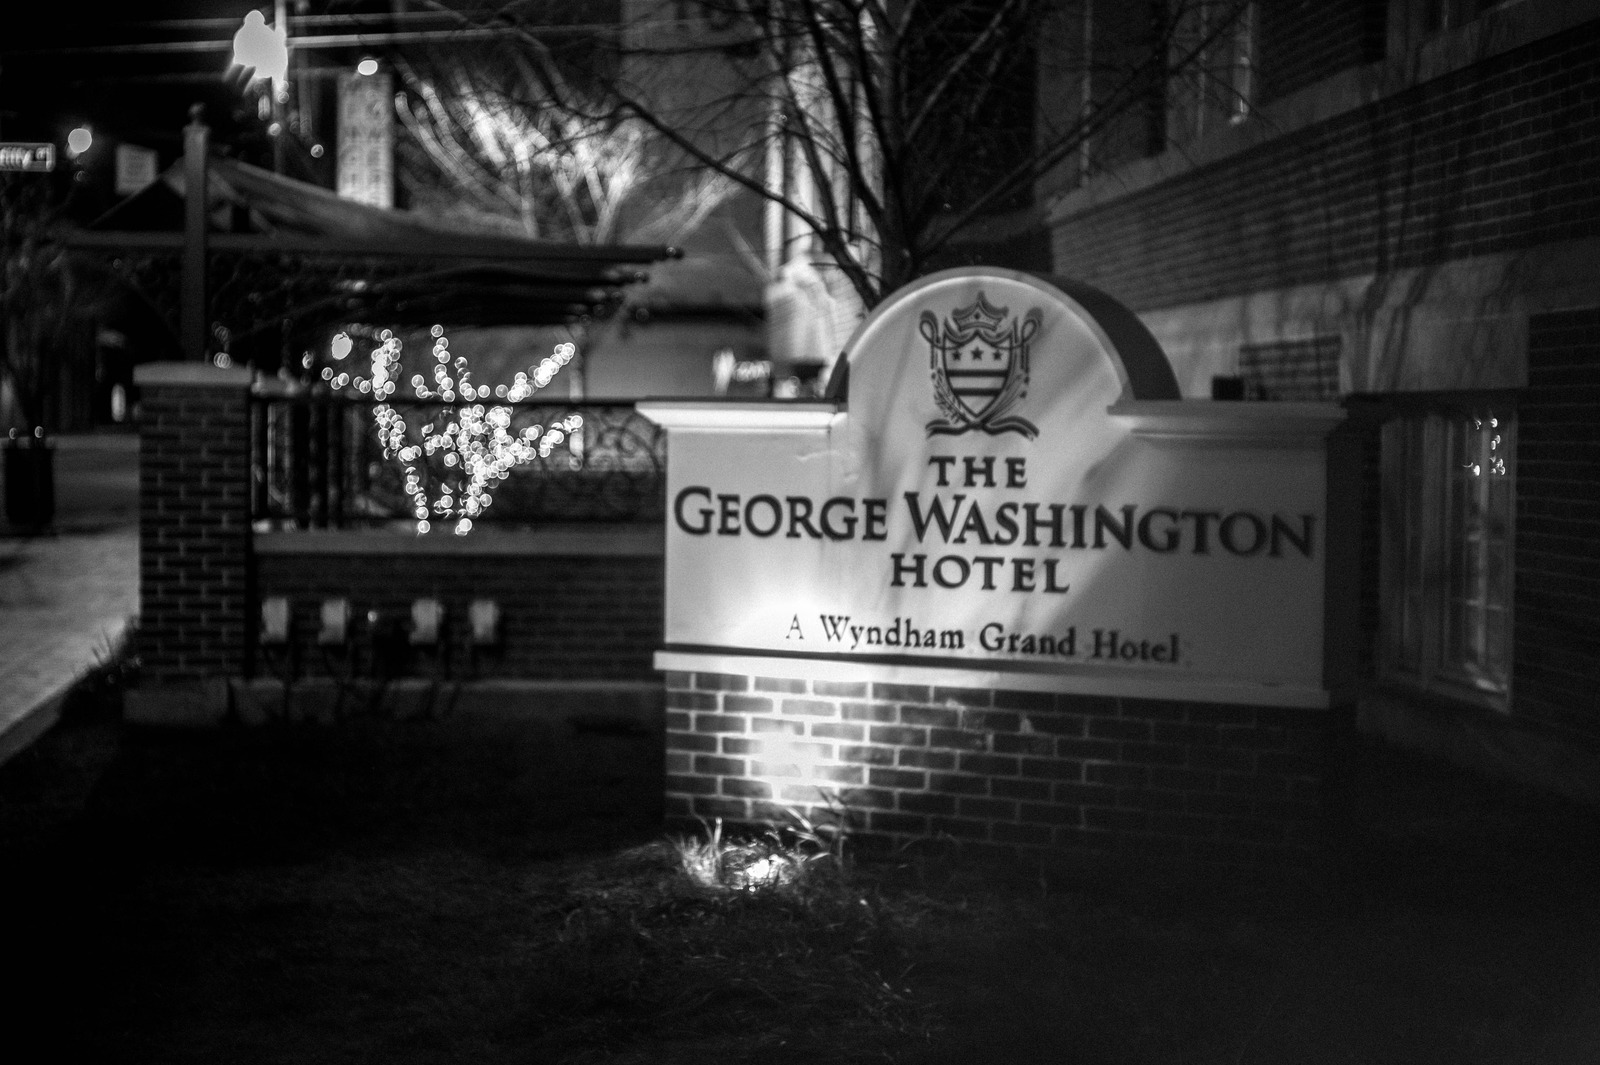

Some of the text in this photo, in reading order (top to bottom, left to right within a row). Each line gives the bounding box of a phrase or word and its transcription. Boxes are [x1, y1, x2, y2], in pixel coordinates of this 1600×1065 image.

[929, 456, 1027, 488] THE
[674, 485, 1317, 558] GEORGE WASHINGTON
[890, 553, 1070, 594] HOTEL
[785, 613, 1179, 664] A Wyndham Grand Hotel
